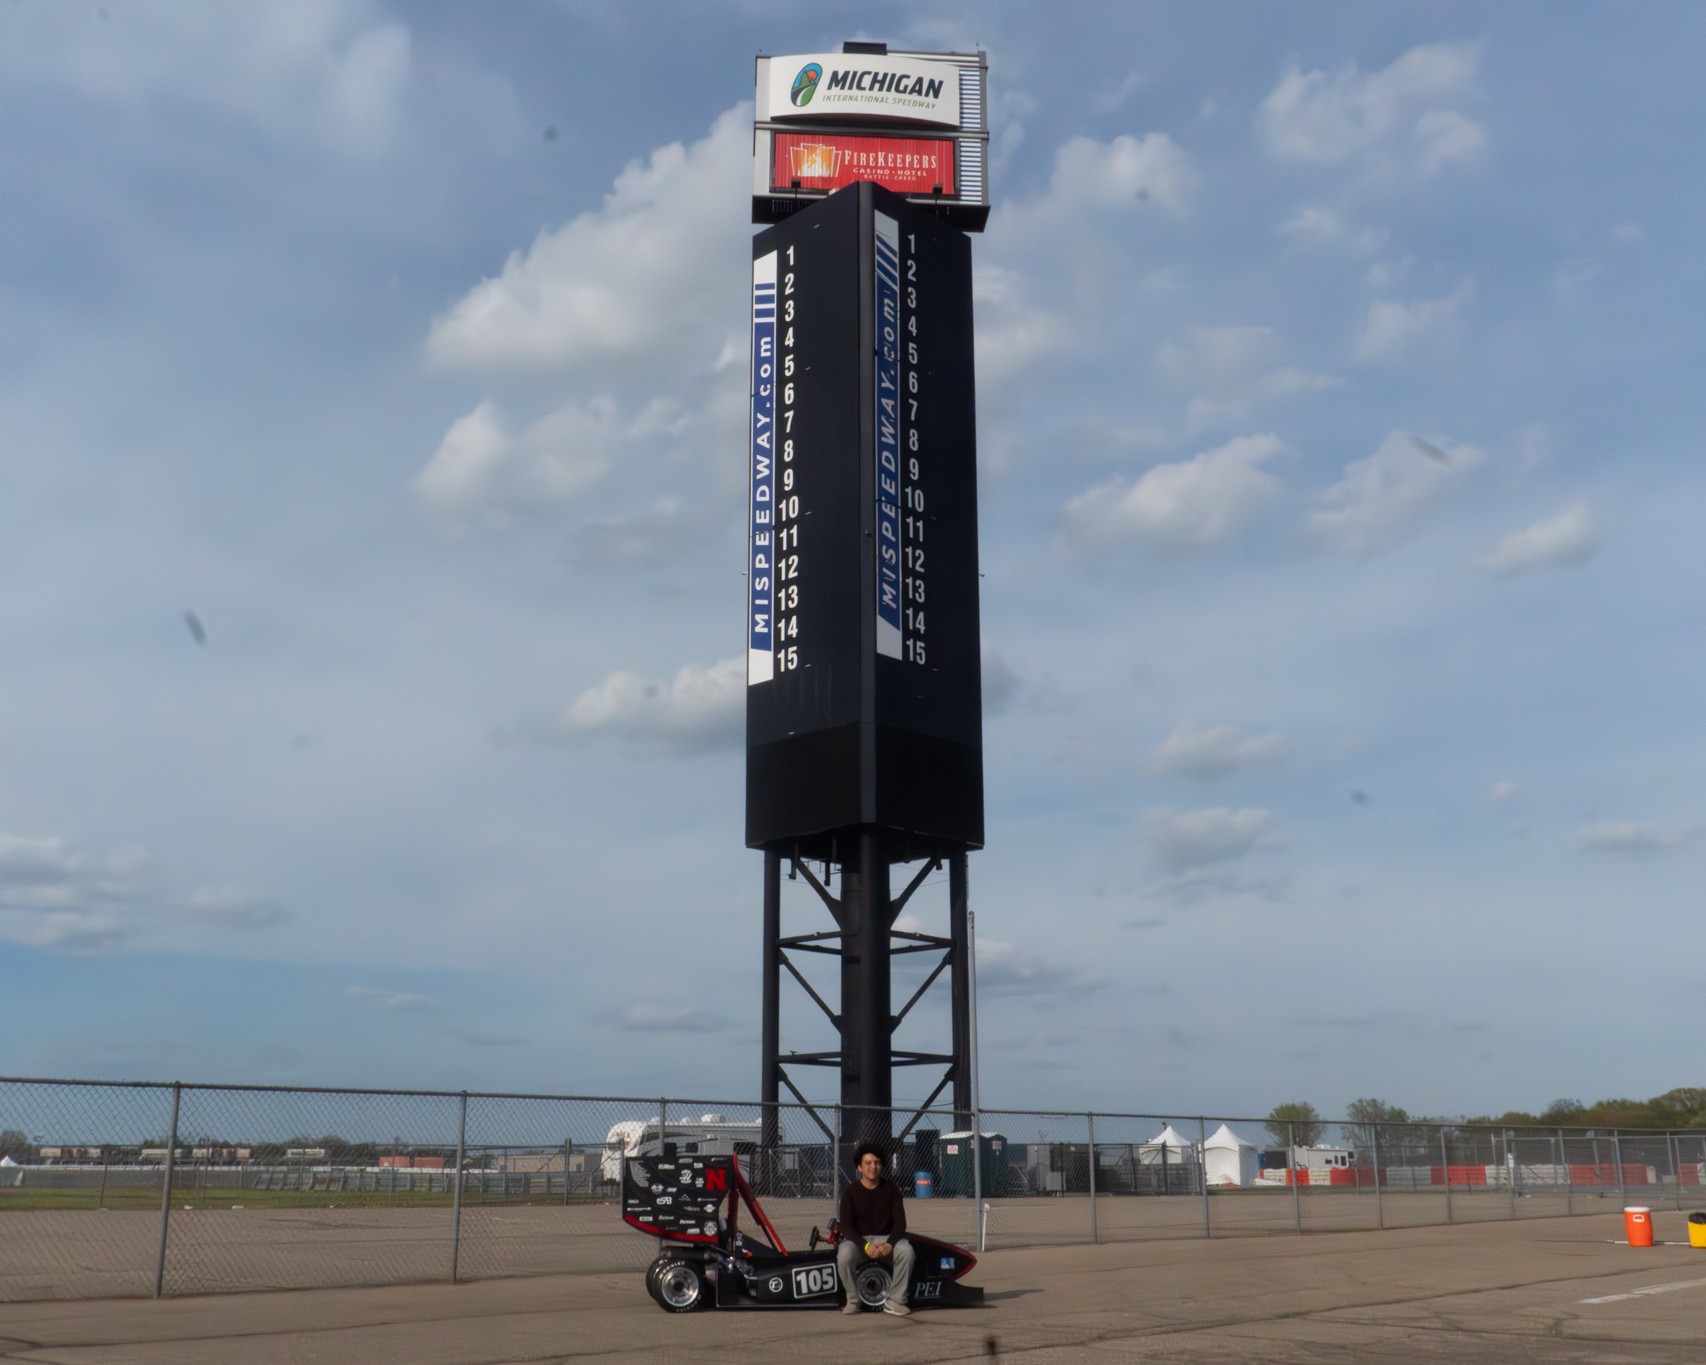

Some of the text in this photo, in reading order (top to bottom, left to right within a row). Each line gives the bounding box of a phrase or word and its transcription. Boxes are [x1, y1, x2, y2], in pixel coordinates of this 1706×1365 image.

[827, 70, 944, 100] MICHIGAN
[822, 95, 936, 109] INTERNATIONAL SPEEDWAY
[853, 167, 890, 175] CASINO
[786, 245, 794, 266] 1
[908, 234, 915, 254] 1
[907, 260, 917, 282] 2
[785, 273, 794, 295] 2
[907, 287, 917, 309] 3
[785, 300, 794, 322] 3
[785, 327, 794, 348] 4
[908, 316, 917, 337] 4
[908, 342, 918, 365] 5
[785, 354, 794, 377] 5
[785, 383, 794, 405] 6
[909, 371, 918, 394] 6
[909, 399, 918, 421] 7
[785, 410, 794, 434] 7
[784, 440, 794, 463] 8
[909, 429, 919, 451] 8
[881, 298, 896, 609] MISPEEDWAY.com
[784, 469, 794, 492] 9
[909, 458, 919, 480] 9
[754, 336, 771, 634] MISPEEDWAY.com
[779, 496, 798, 522] 10
[905, 486, 924, 513] 10
[780, 525, 798, 551] 11
[906, 516, 924, 543] 11
[778, 555, 798, 581] 12
[905, 546, 925, 573] 12
[778, 585, 798, 611] 13
[905, 577, 925, 603] 13
[778, 616, 798, 642] 14
[906, 608, 925, 634] 14
[777, 646, 798, 673] 15
[906, 639, 926, 665] 15
[705, 1168, 727, 1191] N
[796, 1268, 834, 1294] 105
[914, 1281, 943, 1297] PEI
